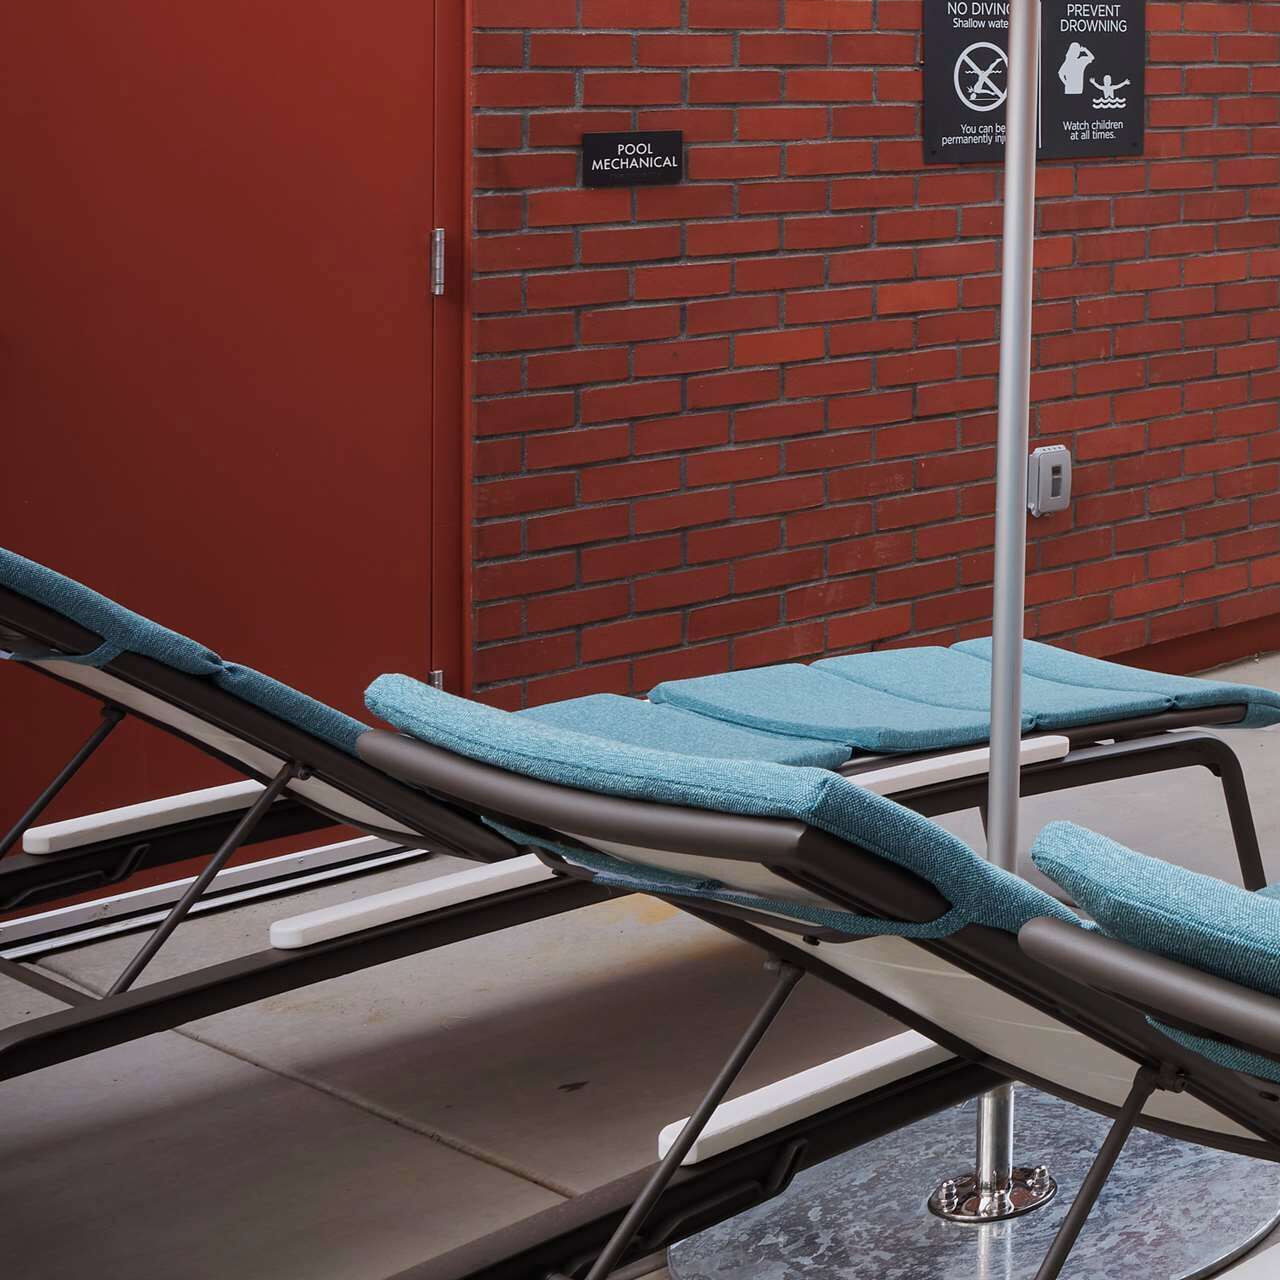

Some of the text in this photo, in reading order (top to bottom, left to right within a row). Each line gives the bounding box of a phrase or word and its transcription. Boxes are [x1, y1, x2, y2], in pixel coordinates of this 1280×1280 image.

[947, 2, 968, 15] NO
[1067, 4, 1121, 18] PREVENT
[953, 18, 986, 29] Shallow
[1060, 19, 1127, 33] DROWNING
[961, 122, 1006, 134] You can be
[1062, 119, 1124, 131] Watch children
[941, 133, 992, 147] permanently
[1070, 130, 1116, 140] at all times.
[617, 143, 654, 156] POOL
[591, 155, 678, 171] MECHANICAL
